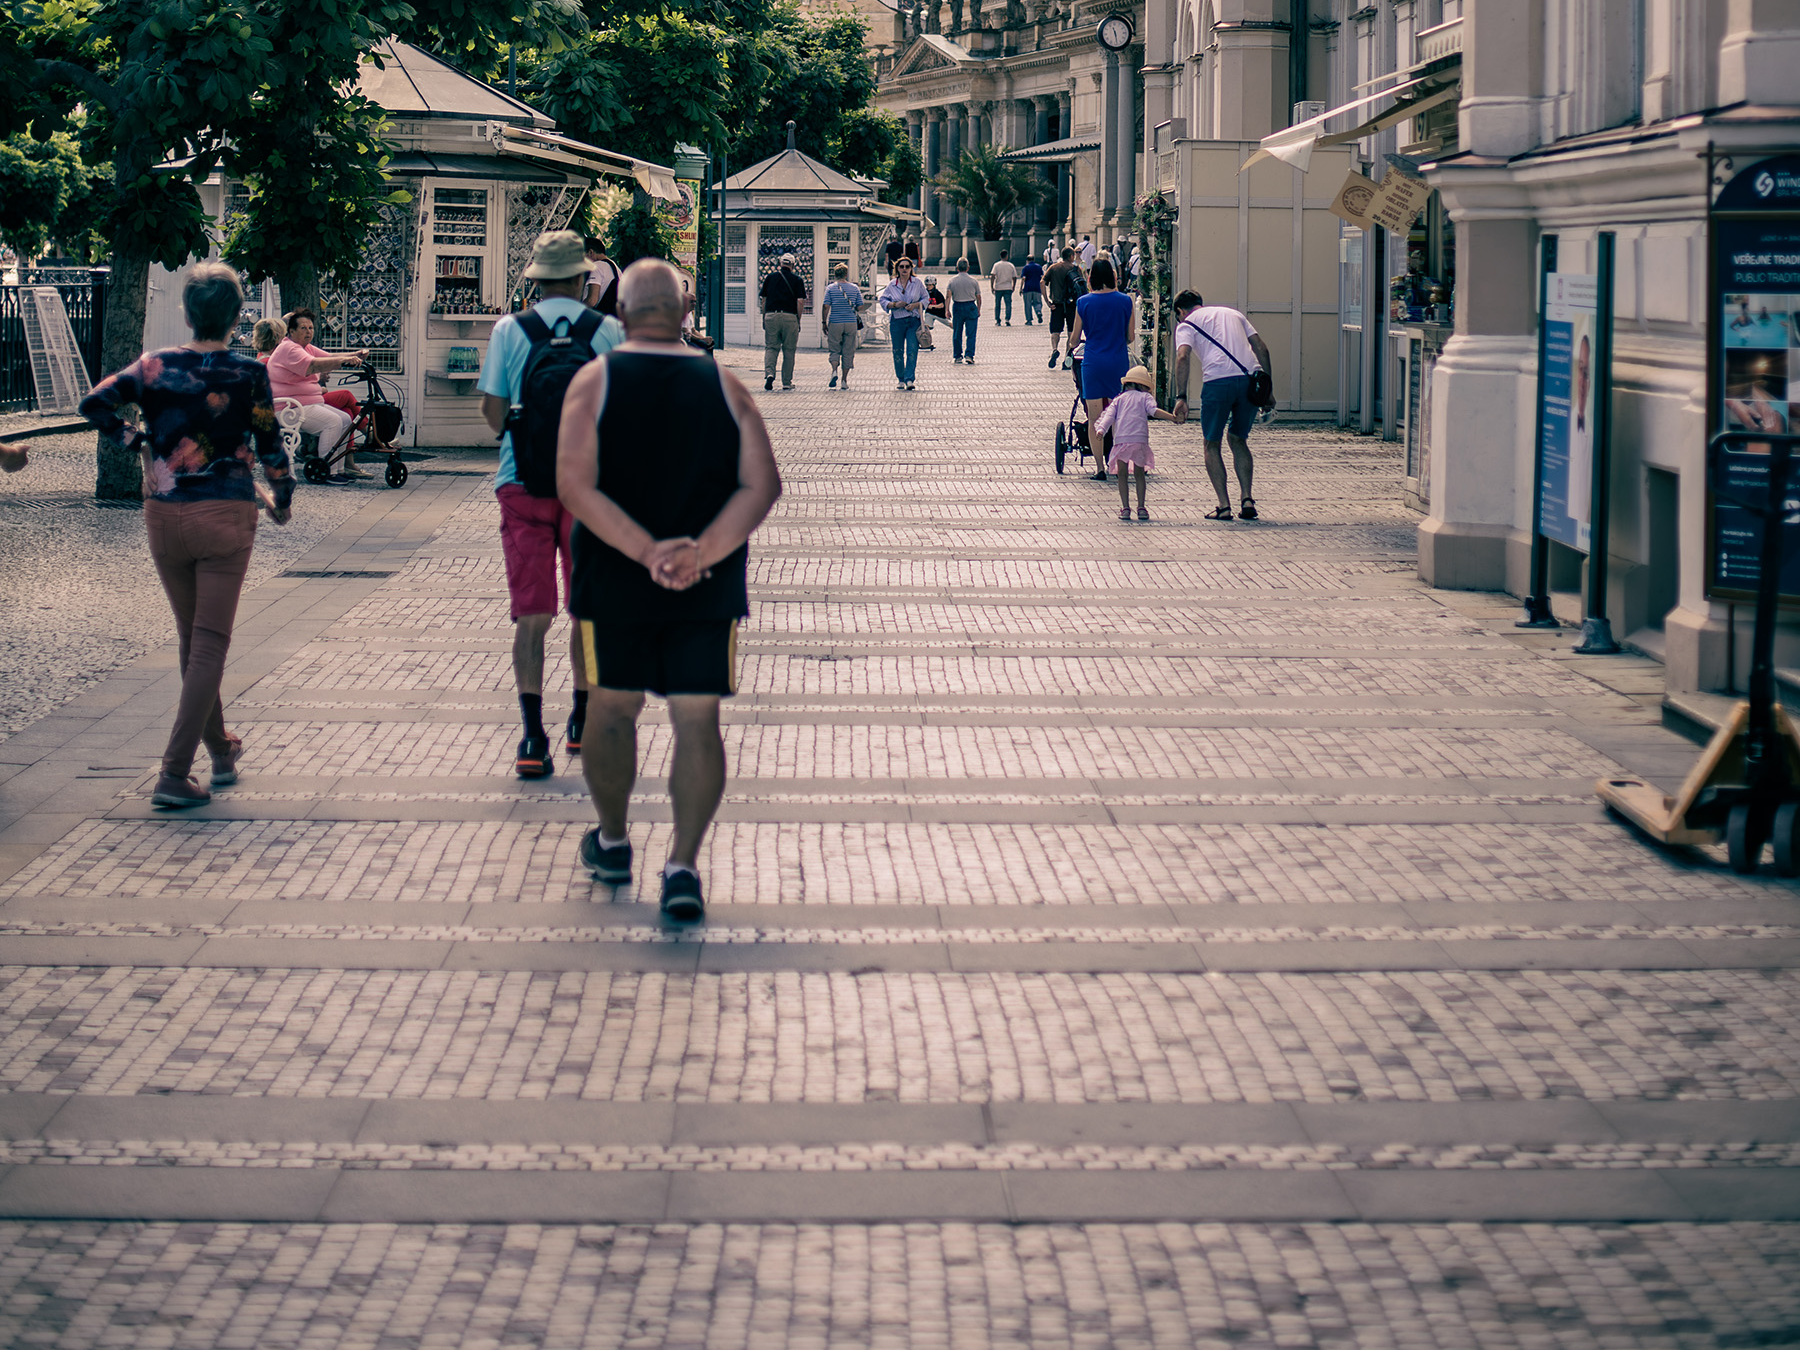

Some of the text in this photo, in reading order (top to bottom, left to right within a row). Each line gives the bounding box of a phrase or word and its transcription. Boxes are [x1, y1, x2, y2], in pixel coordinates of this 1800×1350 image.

[1395, 185, 1414, 198] WAFER
[1733, 252, 1772, 265] VEŘEJNÉ
[1736, 272, 1766, 283] PUBLIC
